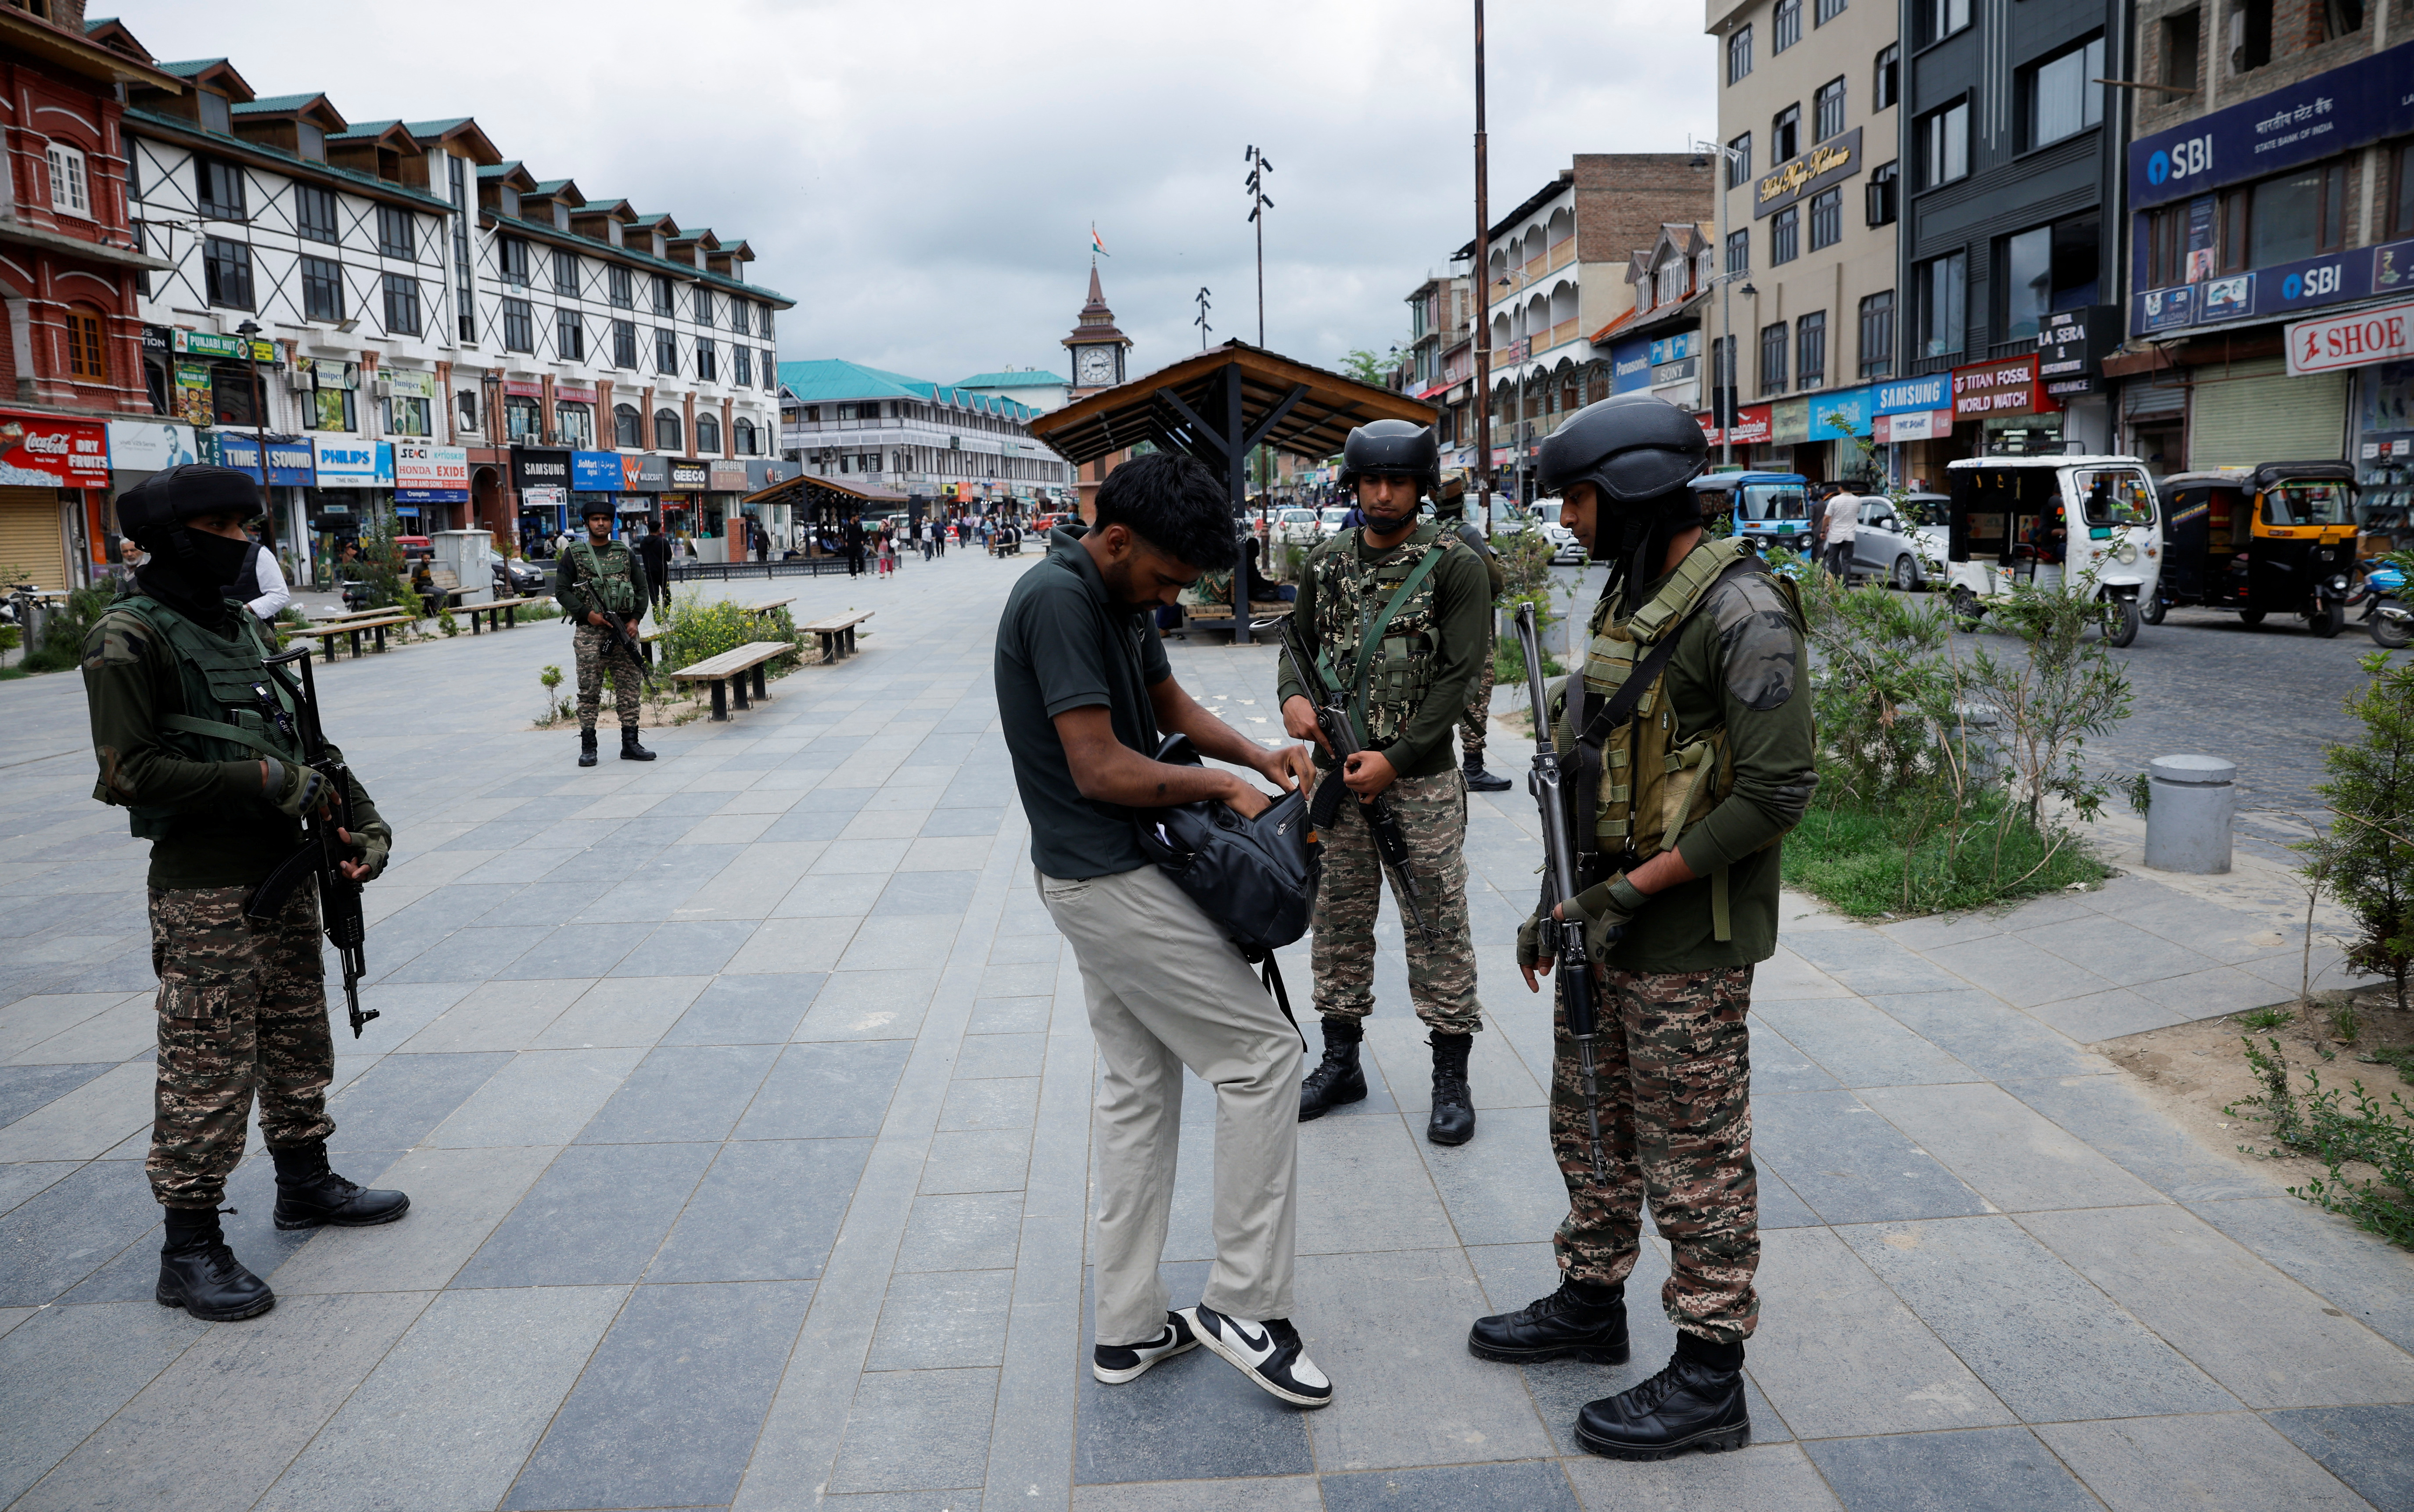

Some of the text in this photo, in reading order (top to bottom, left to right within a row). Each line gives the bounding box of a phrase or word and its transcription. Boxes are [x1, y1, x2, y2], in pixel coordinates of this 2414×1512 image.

[2255, 97, 2333, 134] भारतीय स्टेट बैंक
[2254, 121, 2334, 154] STATE BANK OF INDIA
[2172, 133, 2213, 180] SBI
[2303, 264, 2342, 297] SBI
[2175, 291, 2188, 302] SBI
[2038, 325, 2085, 347] LA SERA
[2327, 316, 2405, 358] SHOE
[190, 335, 236, 351] PUNJABI HUT
[1617, 354, 1648, 377] Panasonic
[318, 371, 343, 380] uniper
[1660, 364, 1685, 381] SONY
[1966, 367, 2031, 390] TITAN FOSSIL
[1880, 381, 1940, 409] SAMSUNG
[1958, 391, 2027, 413] WORLD WATCH
[1941, 418, 1949, 427] LG
[1882, 425, 1888, 434] LG
[76, 439, 99, 453] DRY
[199, 441, 208, 456] Y
[224, 449, 258, 467] TIME
[271, 450, 312, 469] SOUND
[321, 449, 370, 464] PHILIPS
[401, 449, 427, 459] SENCI
[68, 455, 108, 468] FRUITS
[578, 459, 597, 468] JioMart
[718, 461, 741, 470] BIG BEN
[399, 466, 431, 475] HONDA
[437, 466, 465, 477] EXIDE
[525, 463, 565, 476] SAMSUNG
[673, 469, 706, 482] GEECO
[774, 470, 783, 481] LG
[1503, 465, 1511, 474] P
[640, 473, 663, 482] WILDCRAFT
[725, 473, 741, 483] TITAN
